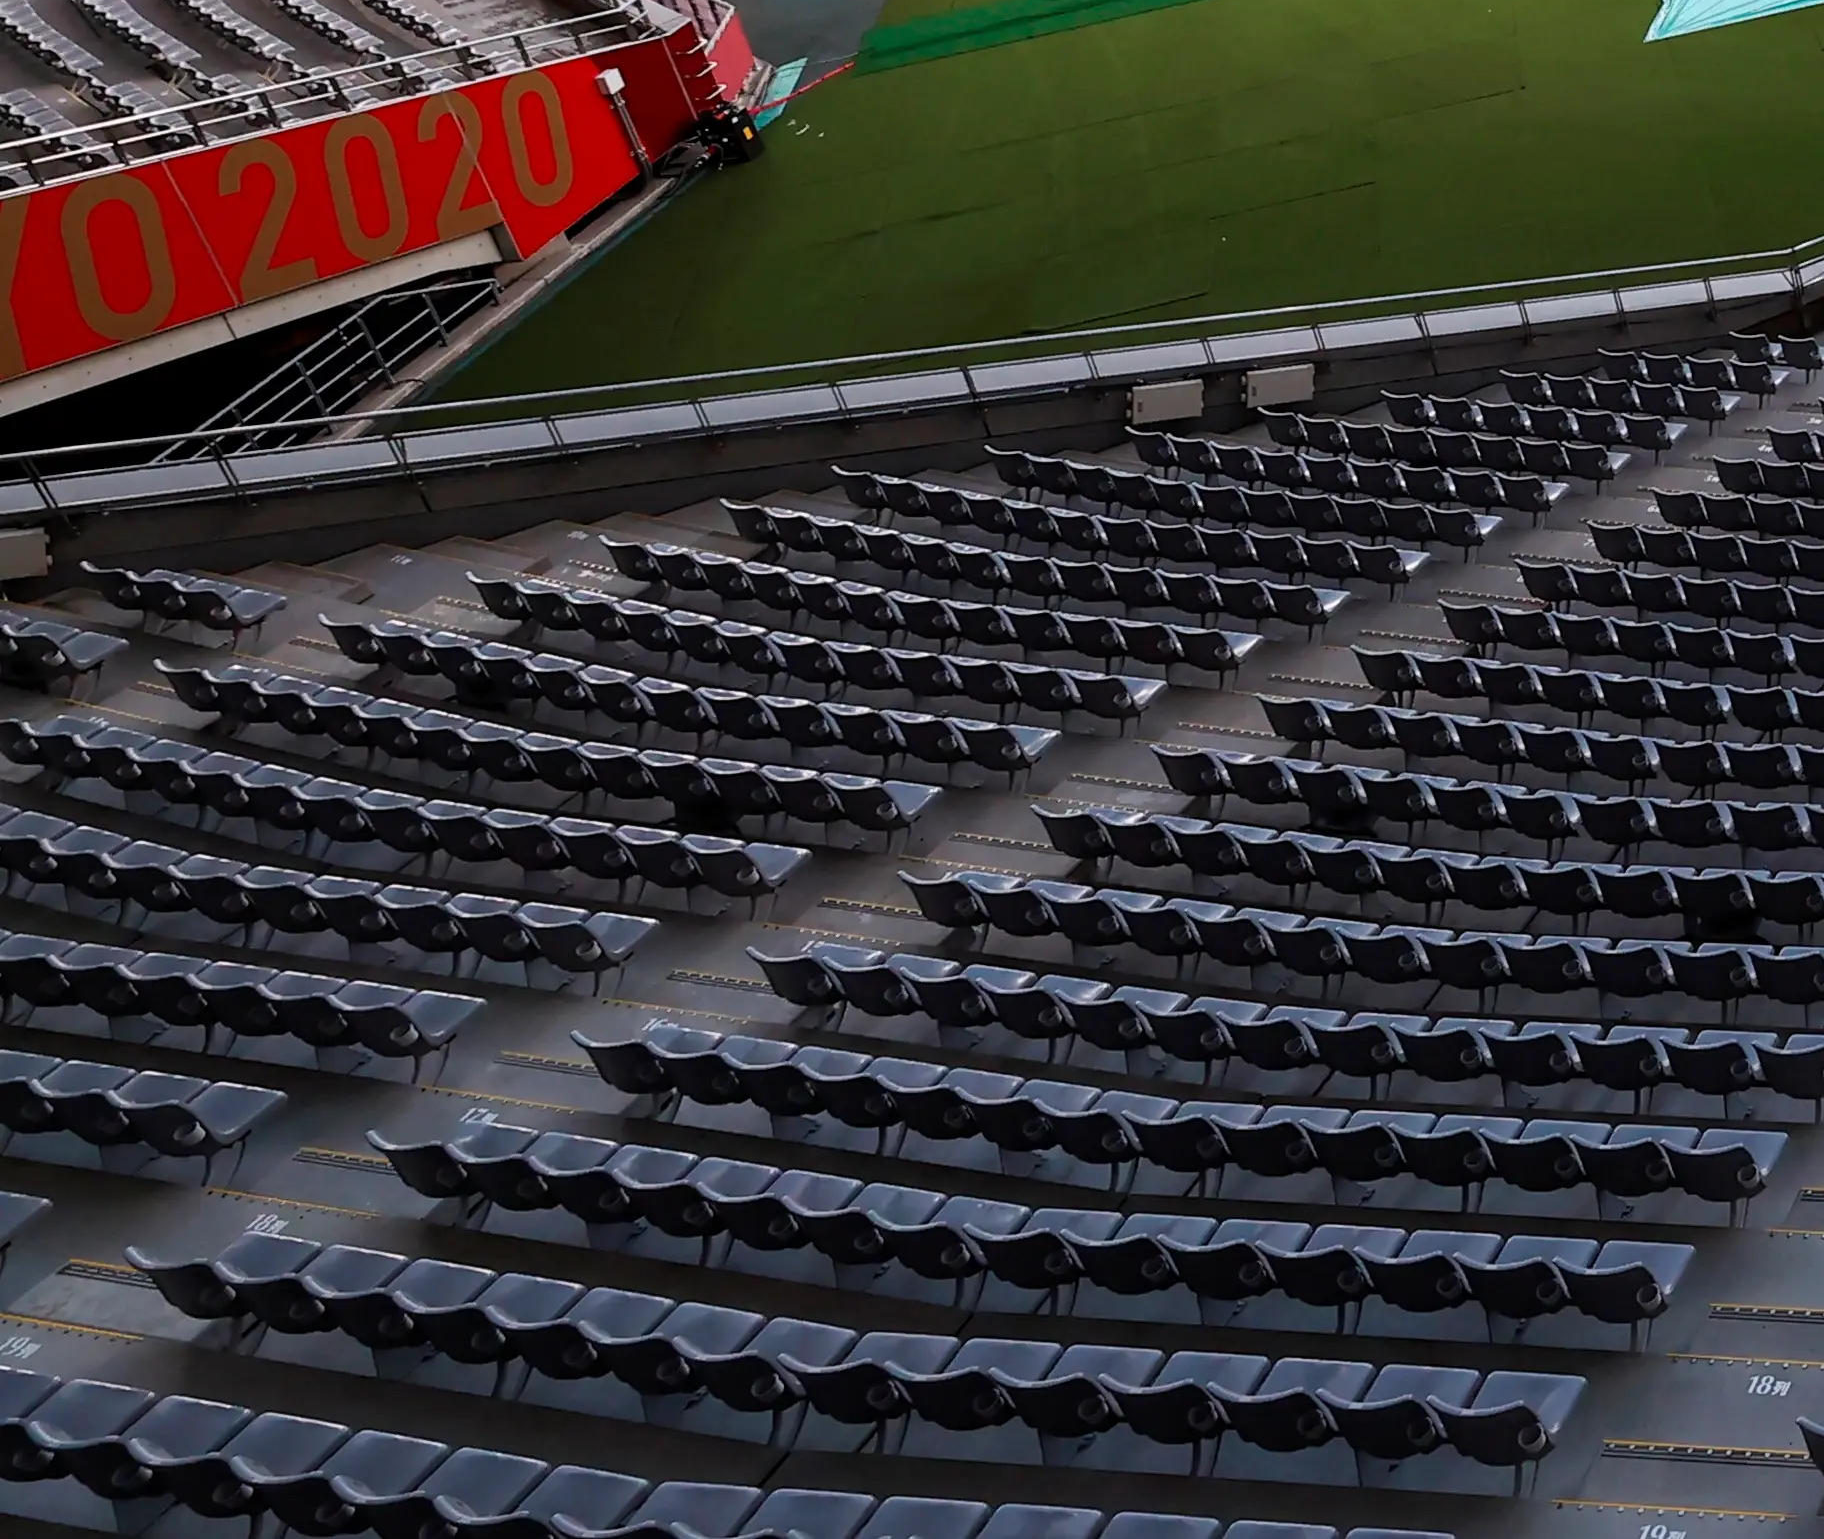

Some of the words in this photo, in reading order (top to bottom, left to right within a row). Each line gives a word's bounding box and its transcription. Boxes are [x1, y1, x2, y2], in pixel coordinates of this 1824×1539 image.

[0, 172, 176, 376] O
[217, 71, 573, 304] 2020
[1747, 1375, 1792, 1397] 18列
